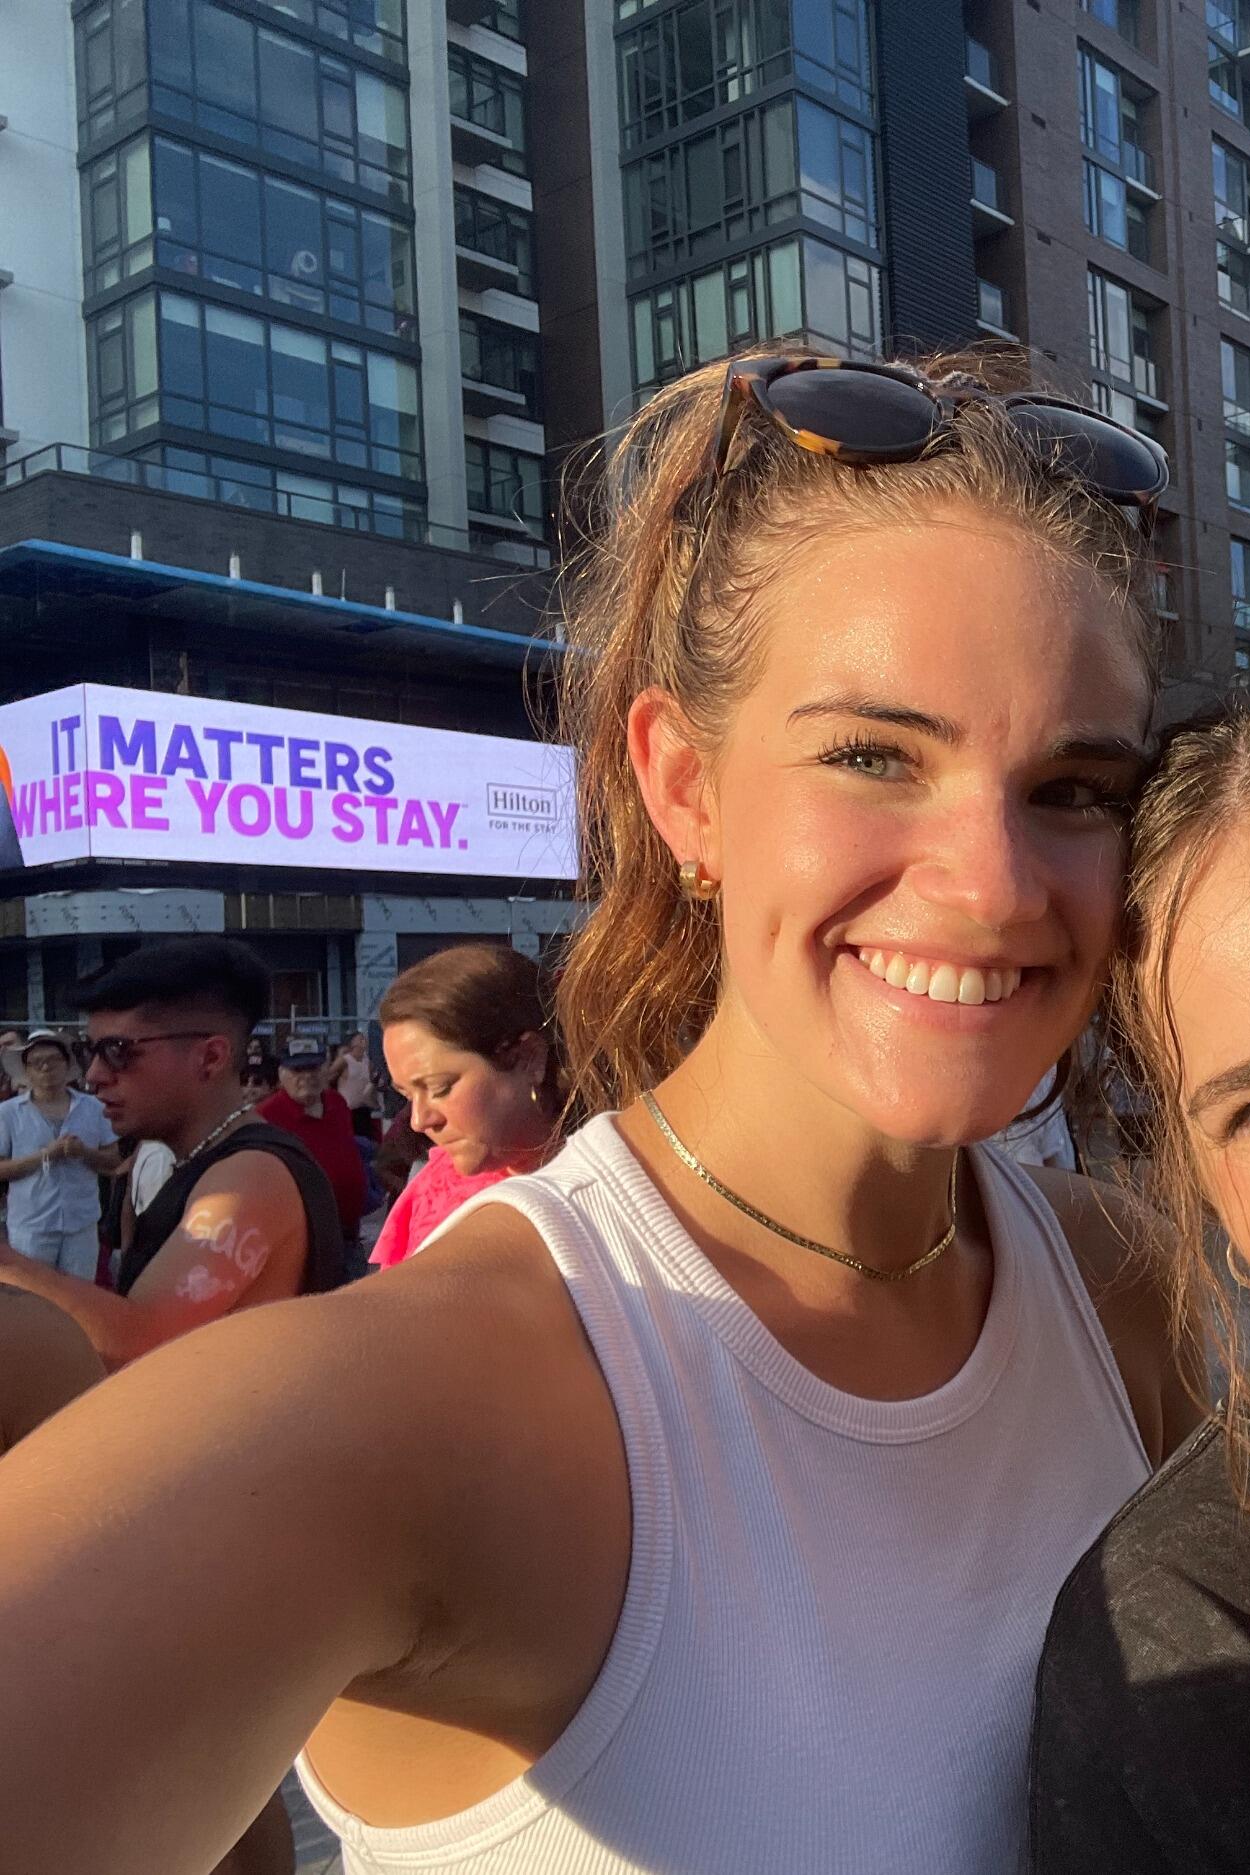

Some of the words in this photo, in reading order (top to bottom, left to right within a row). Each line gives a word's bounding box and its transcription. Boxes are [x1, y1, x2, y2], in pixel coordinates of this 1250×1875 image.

[52, 715, 80, 775] IT
[98, 715, 394, 795] MATTERS
[14, 771, 169, 838] WHERE
[185, 778, 313, 839] YOU
[331, 791, 468, 850] STAY.
[489, 820, 508, 830] FOR
[512, 822, 530, 832] THE
[534, 823, 556, 834] STAY
[493, 790, 551, 814] Hilton
